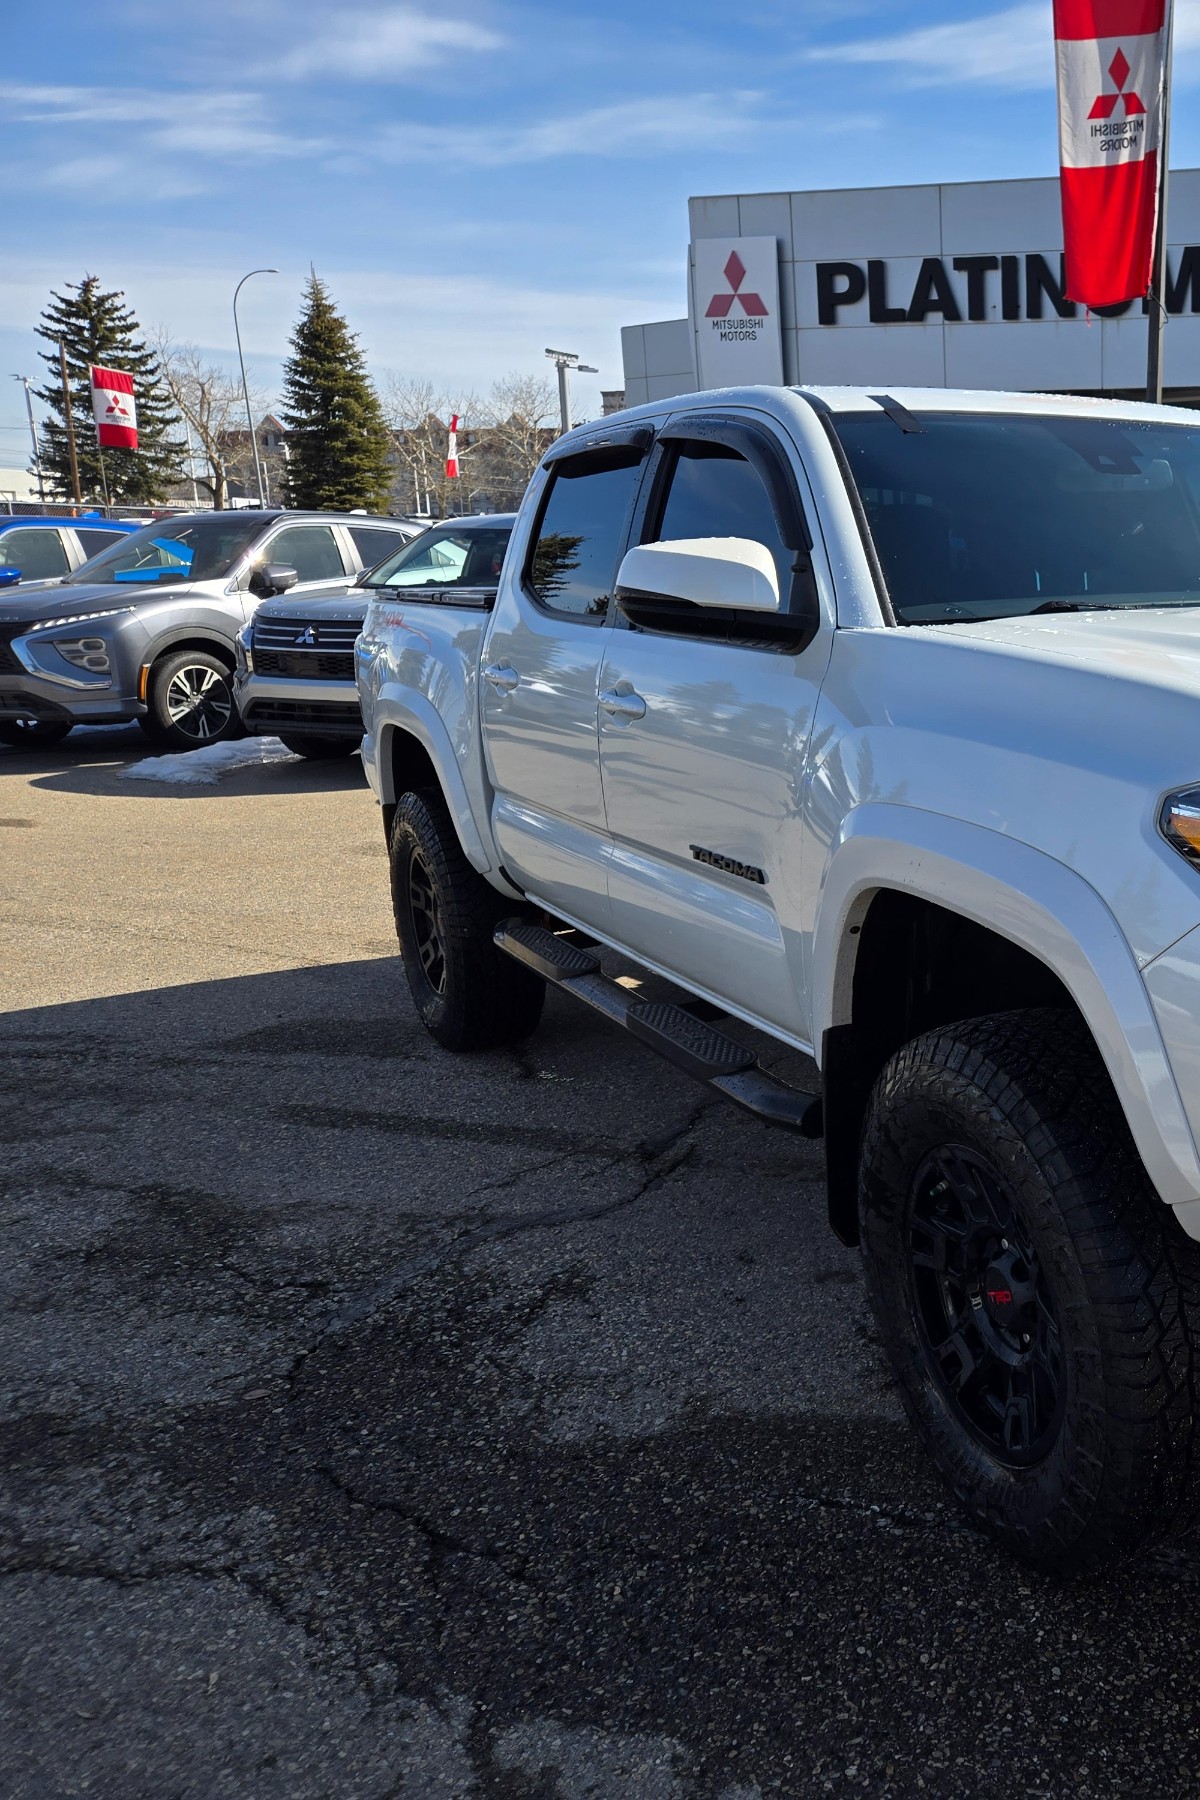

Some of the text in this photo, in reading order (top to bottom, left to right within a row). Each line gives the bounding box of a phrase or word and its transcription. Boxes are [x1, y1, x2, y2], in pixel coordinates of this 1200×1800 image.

[712, 319, 764, 330] MITSUBISHI
[720, 330, 758, 341] MOTORS
[689, 844, 765, 885] TACOMA
